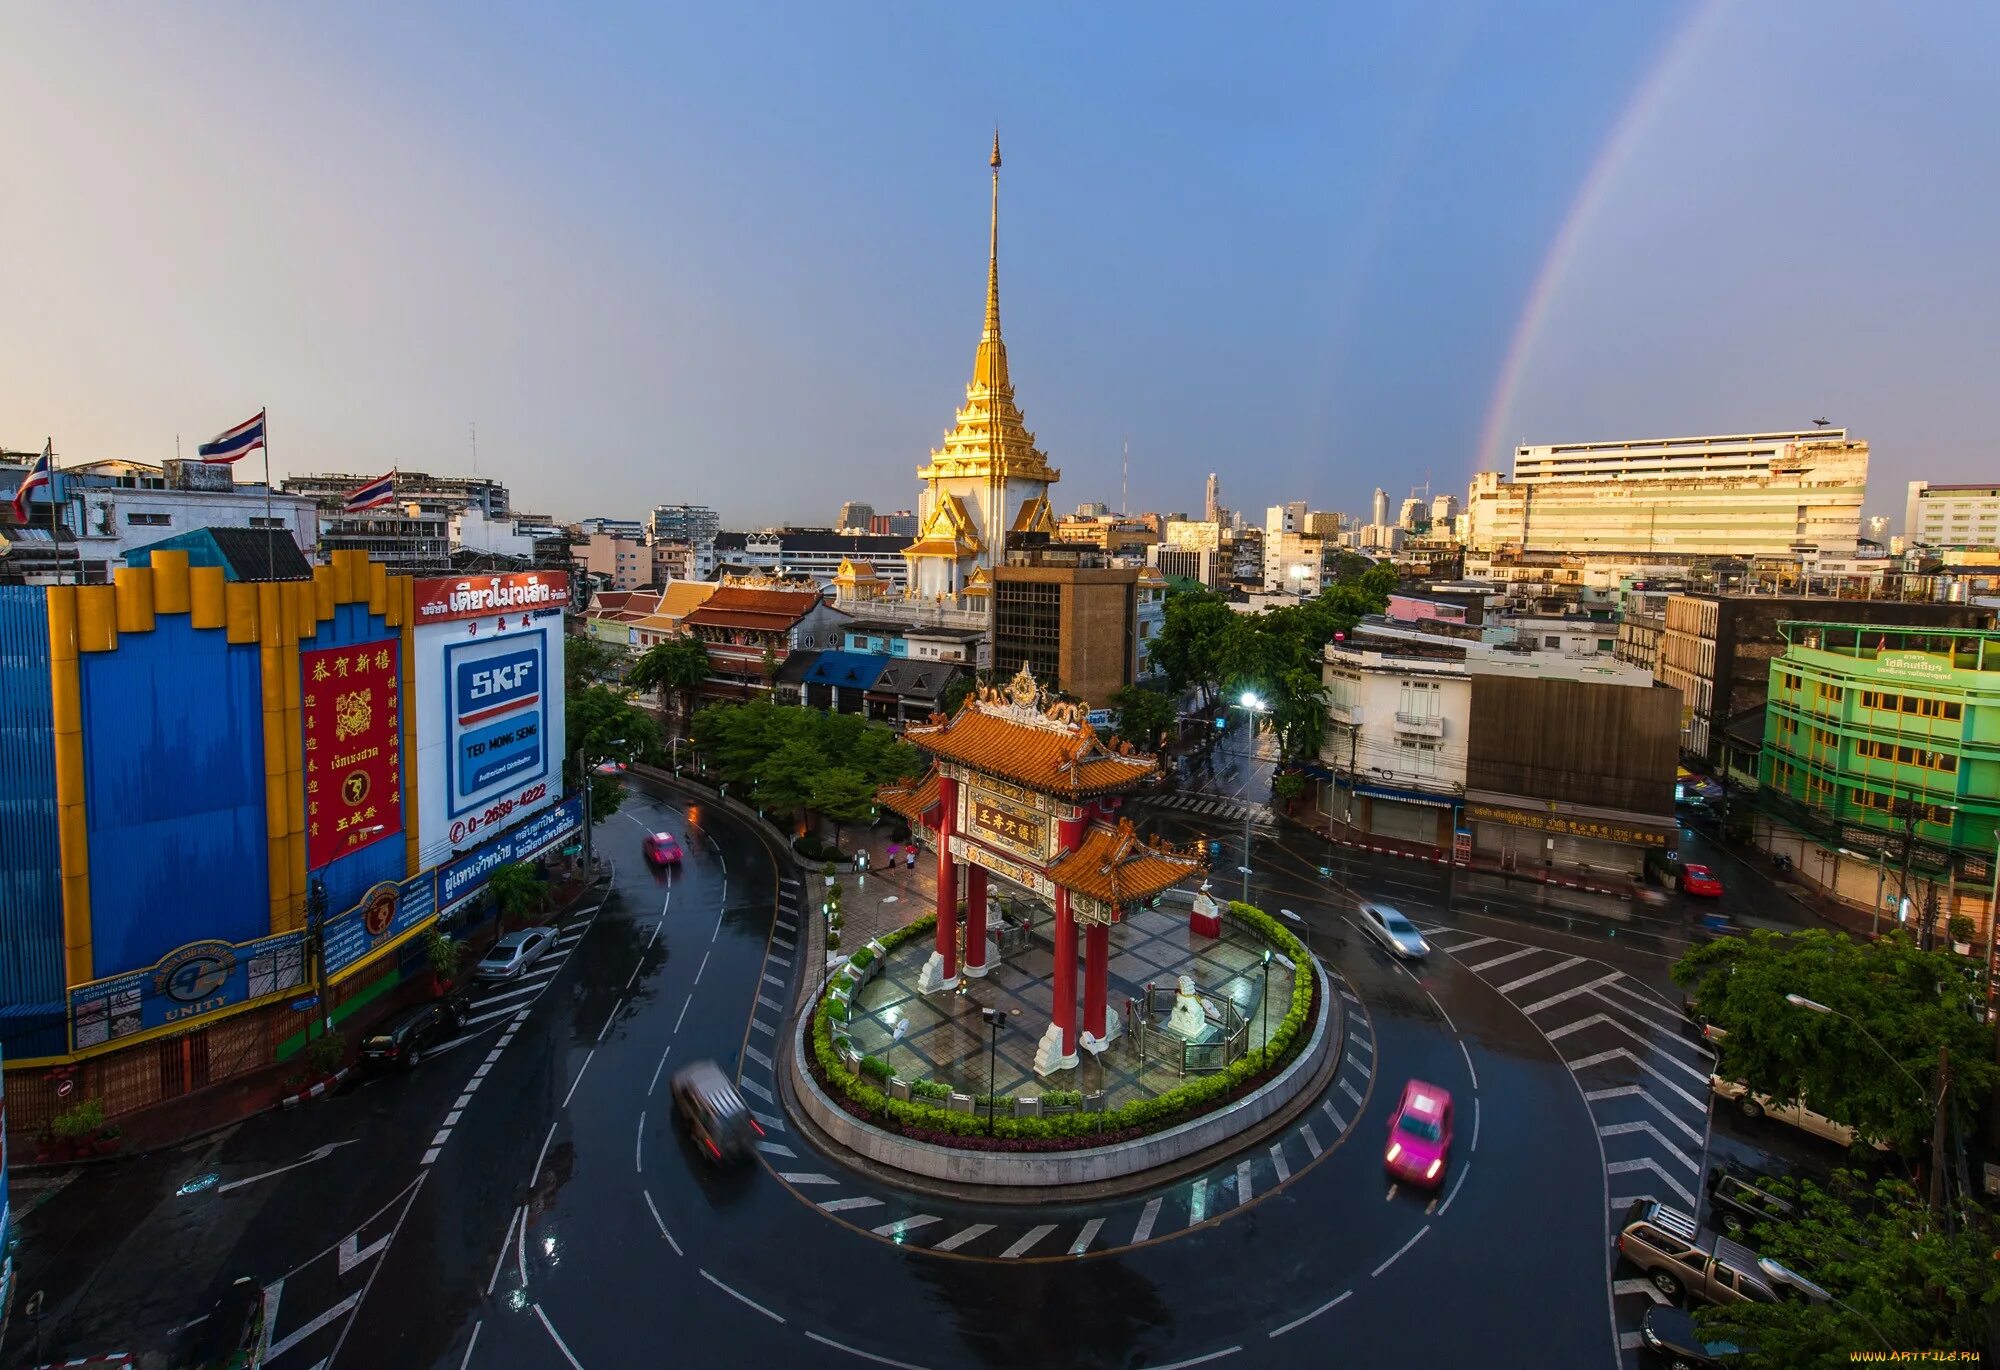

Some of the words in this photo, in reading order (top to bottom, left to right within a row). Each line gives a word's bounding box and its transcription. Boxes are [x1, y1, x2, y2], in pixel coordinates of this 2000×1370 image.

[471, 661, 533, 699] SKF
[466, 742, 485, 759] TEO
[516, 724, 537, 742] SENG
[479, 764, 506, 782] Authorized
[507, 755, 531, 770] Distributor
[164, 995, 227, 1021] UNITY
